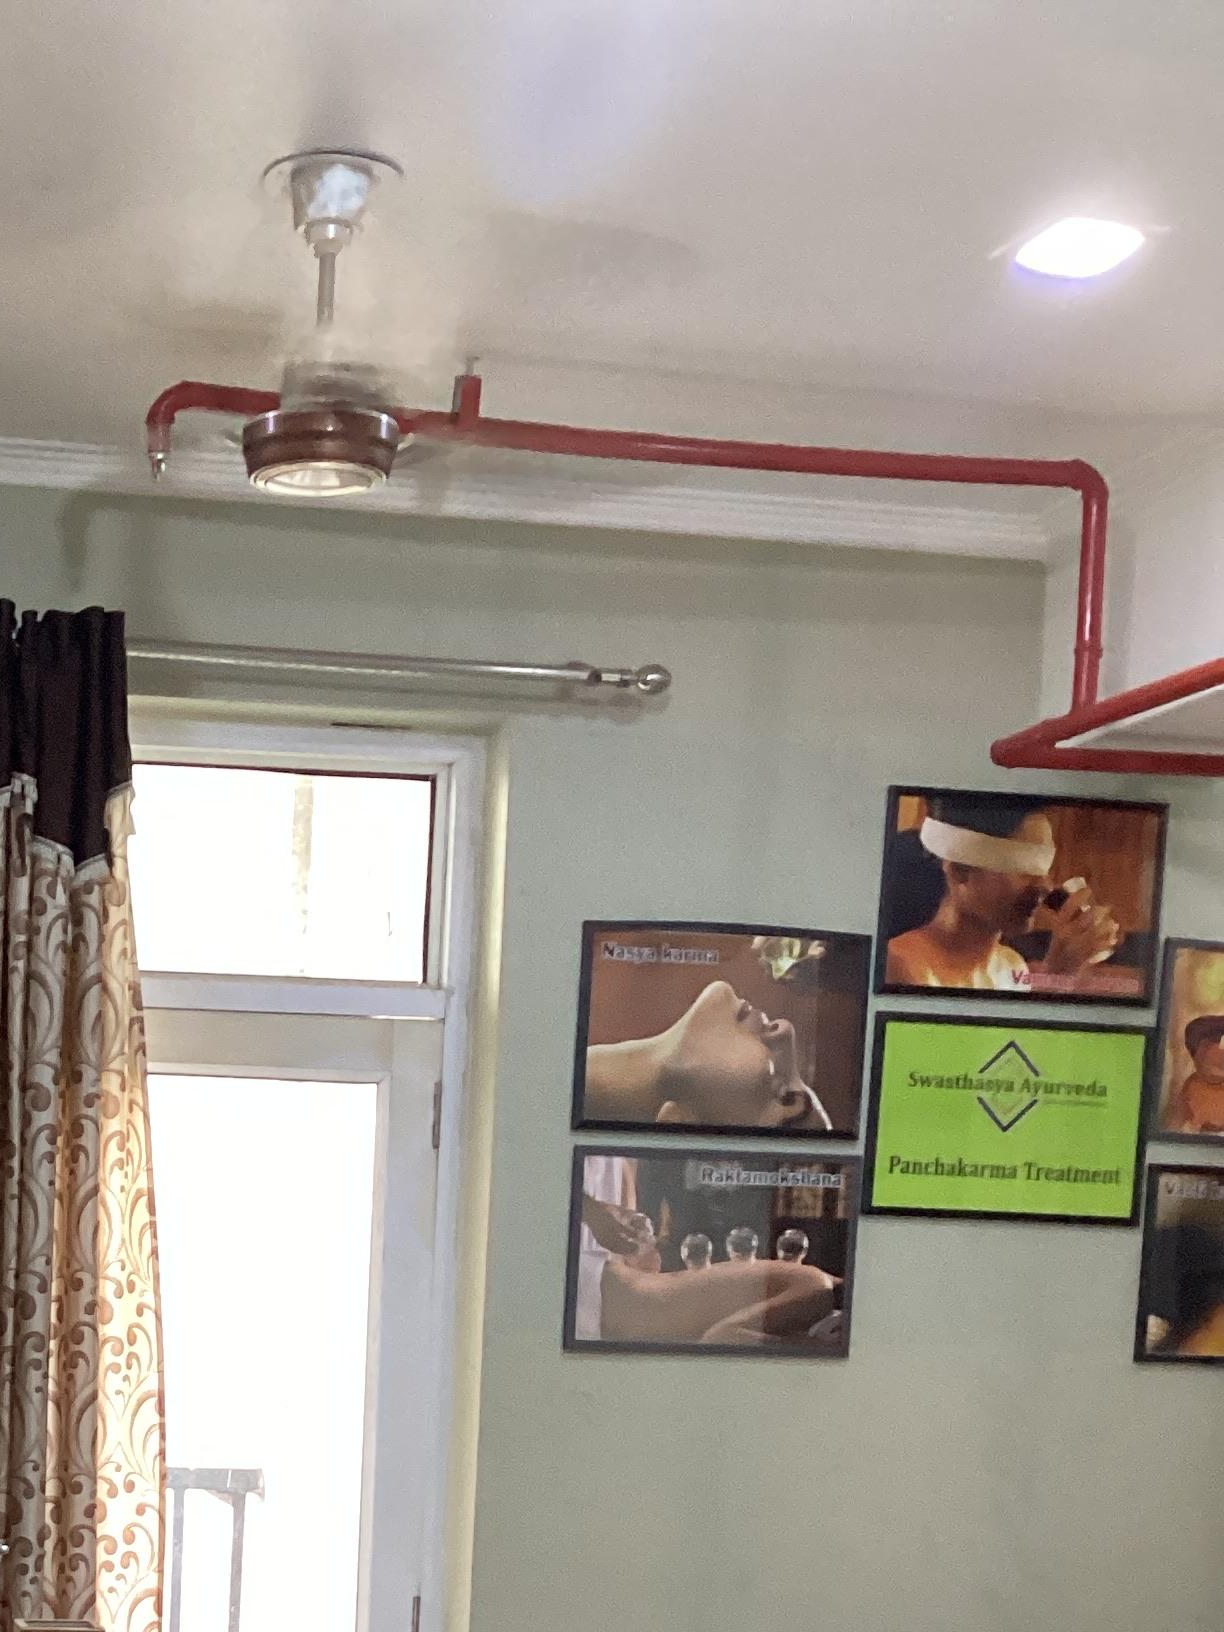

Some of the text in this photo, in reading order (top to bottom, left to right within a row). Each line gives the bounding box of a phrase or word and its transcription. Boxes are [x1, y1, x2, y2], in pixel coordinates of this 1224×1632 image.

[1020, 1078, 1108, 1097] Ayurveda
[888, 1155, 1120, 1184] Panchakarma Treatment
